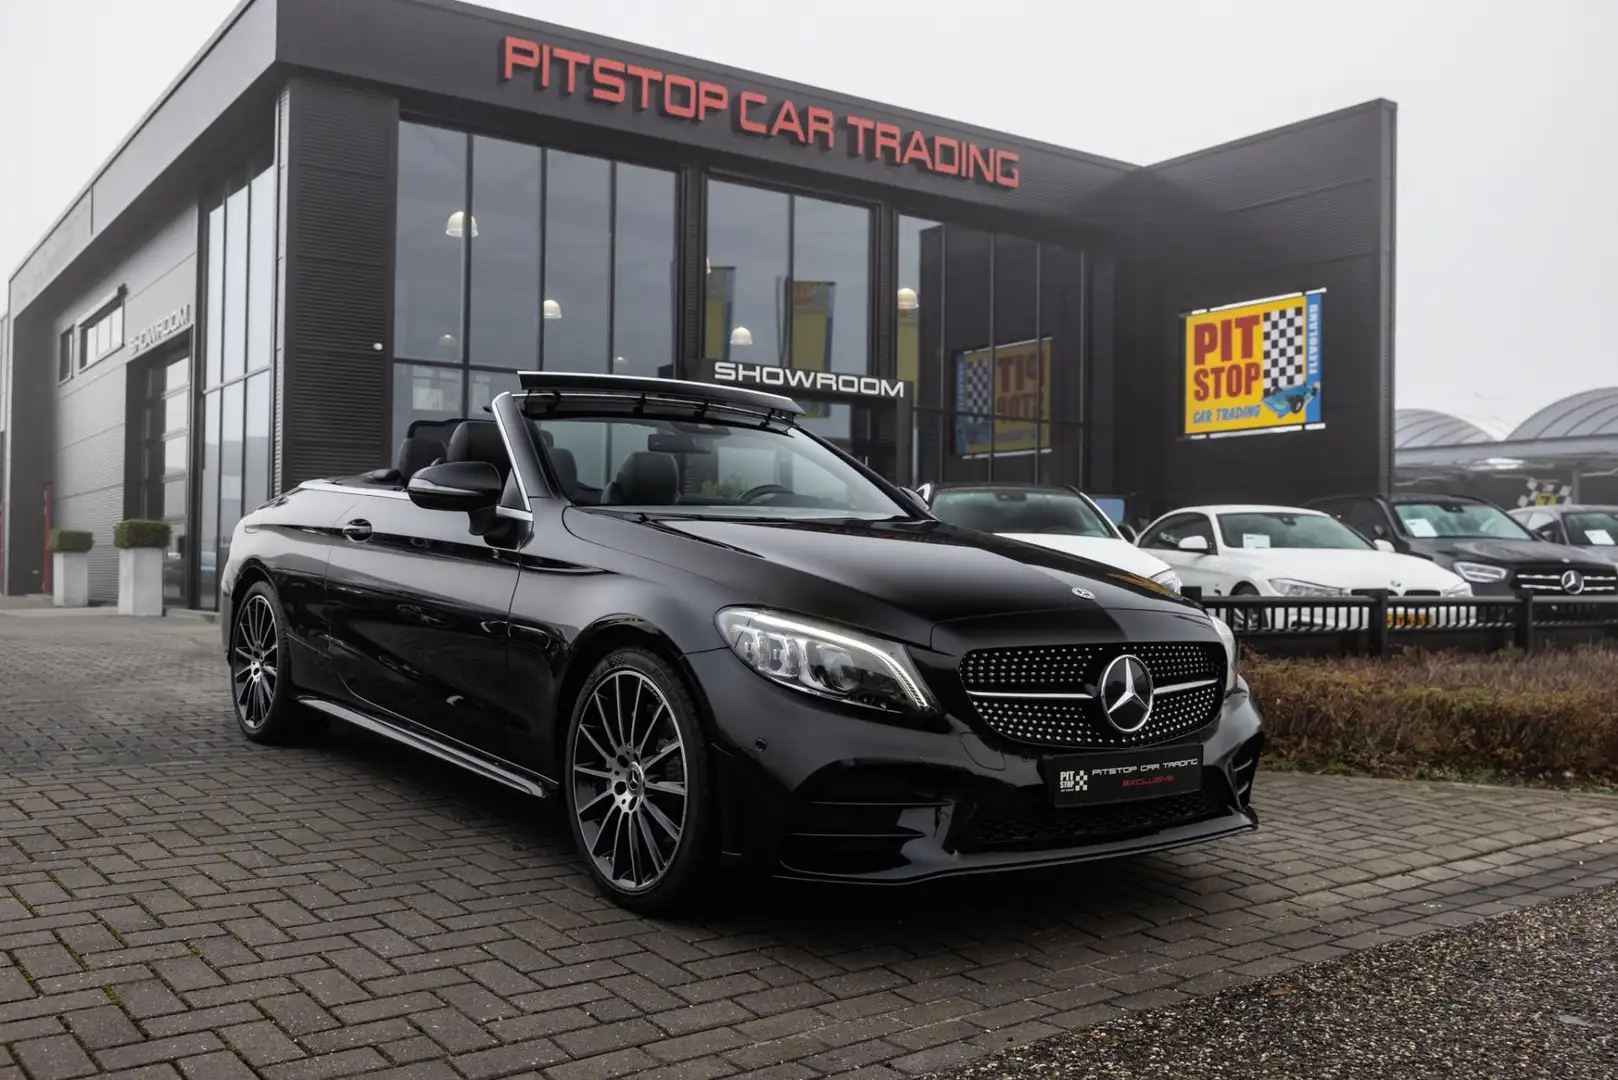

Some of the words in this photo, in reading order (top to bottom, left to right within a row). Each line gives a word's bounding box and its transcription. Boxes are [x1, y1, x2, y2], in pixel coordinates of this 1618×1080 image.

[503, 36, 728, 121] PITSTOP
[739, 90, 834, 149] CAR
[846, 115, 1020, 188] TRADING
[1194, 314, 1260, 366] PIT
[714, 362, 904, 398] SHOWROOM
[1193, 362, 1260, 402] STOP
[1193, 408, 1212, 423] CAR
[1216, 404, 1261, 422] TRADING
[1060, 771, 1075, 781] PIT
[1092, 766, 1138, 776] PITSTOP
[1140, 763, 1160, 772] CAR
[1162, 758, 1198, 768] TRADING
[1059, 781, 1075, 789] STOP
